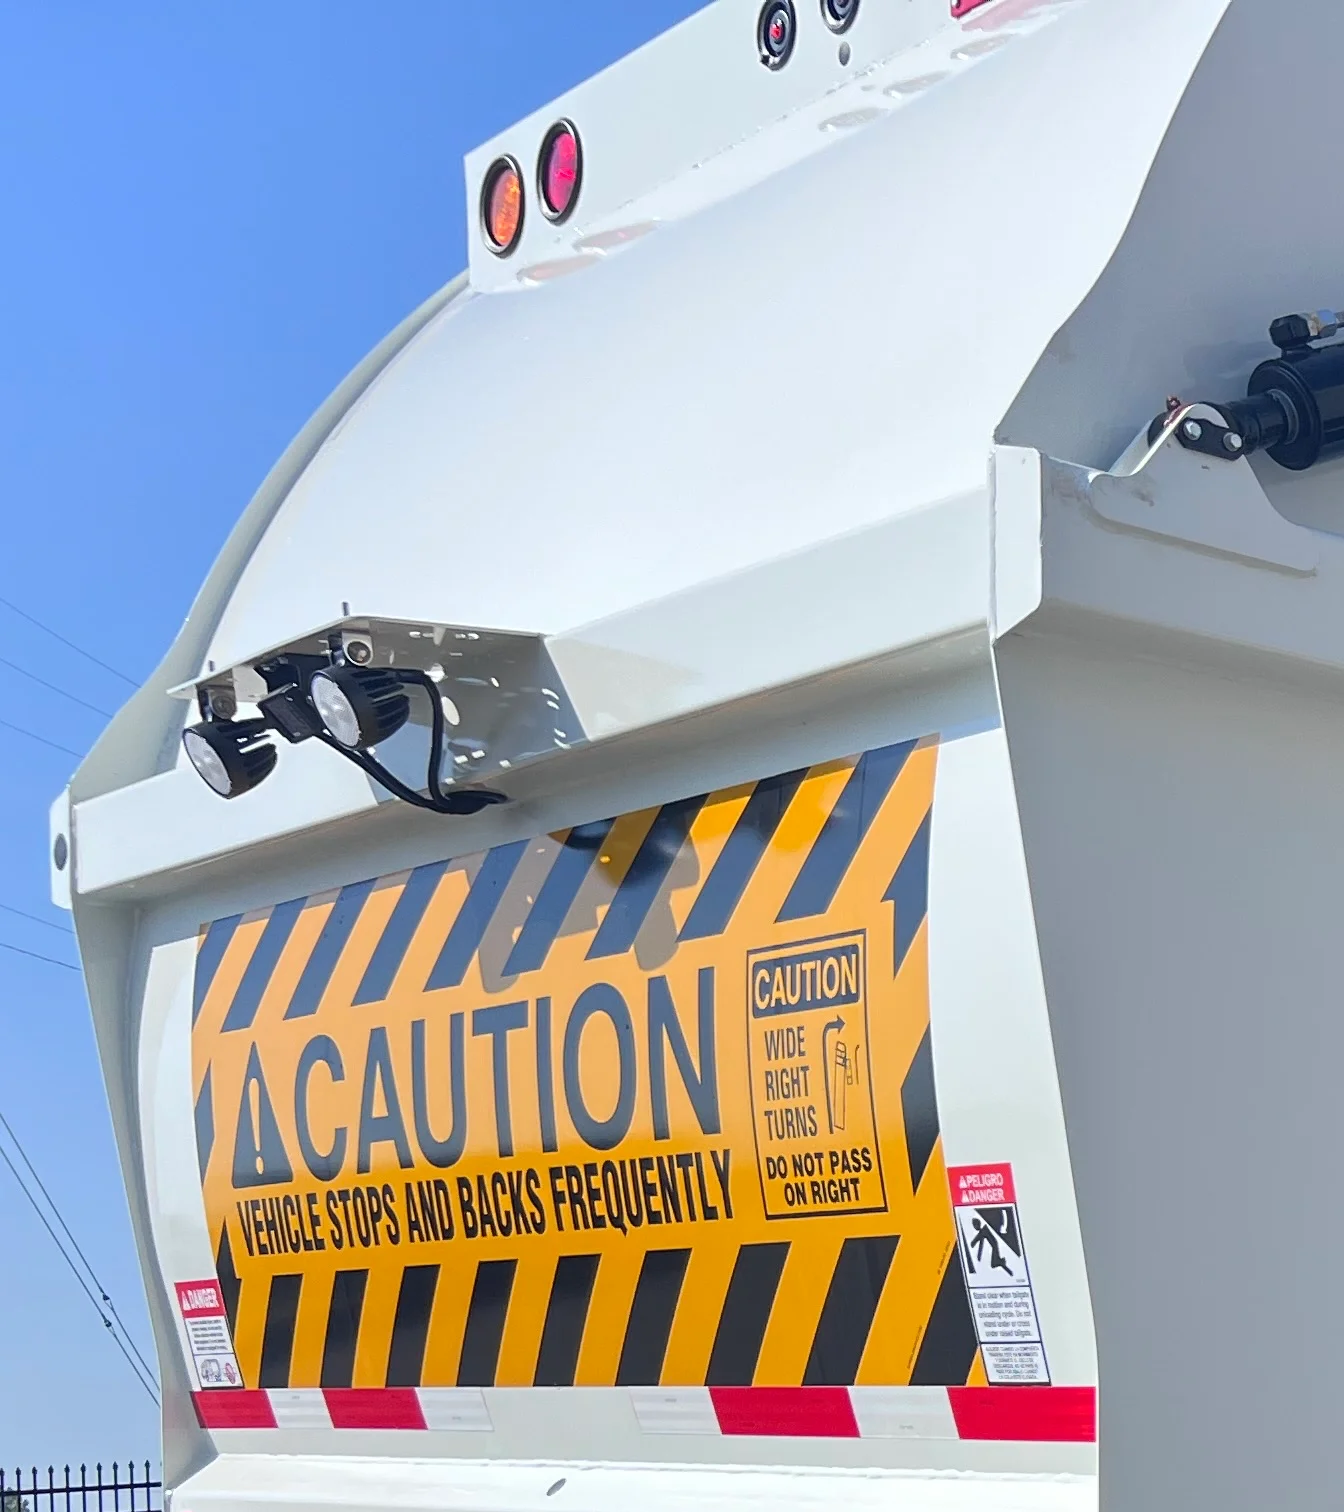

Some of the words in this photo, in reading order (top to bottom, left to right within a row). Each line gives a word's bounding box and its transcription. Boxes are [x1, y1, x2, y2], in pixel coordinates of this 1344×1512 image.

[755, 954, 857, 1009] CAUTION
[764, 1026, 806, 1061] WIDE
[295, 966, 721, 1182] CAUTION
[765, 1066, 809, 1101] RIGHT
[764, 1105, 818, 1140] TURNS
[766, 1156, 787, 1180] DO
[793, 1152, 824, 1178] NOT
[829, 1147, 873, 1174] PASS
[966, 1173, 1004, 1188] PELIGRO
[236, 1193, 325, 1256] VEHICLE
[325, 1183, 400, 1250] STOPS
[405, 1179, 454, 1243] AND
[456, 1168, 546, 1238] BACKS
[549, 1149, 733, 1237] FREQUENTLY
[784, 1181, 808, 1206] ON
[812, 1177, 860, 1203] RIGHT
[968, 1187, 1005, 1202] DANGER
[187, 1288, 220, 1310] DANGER
